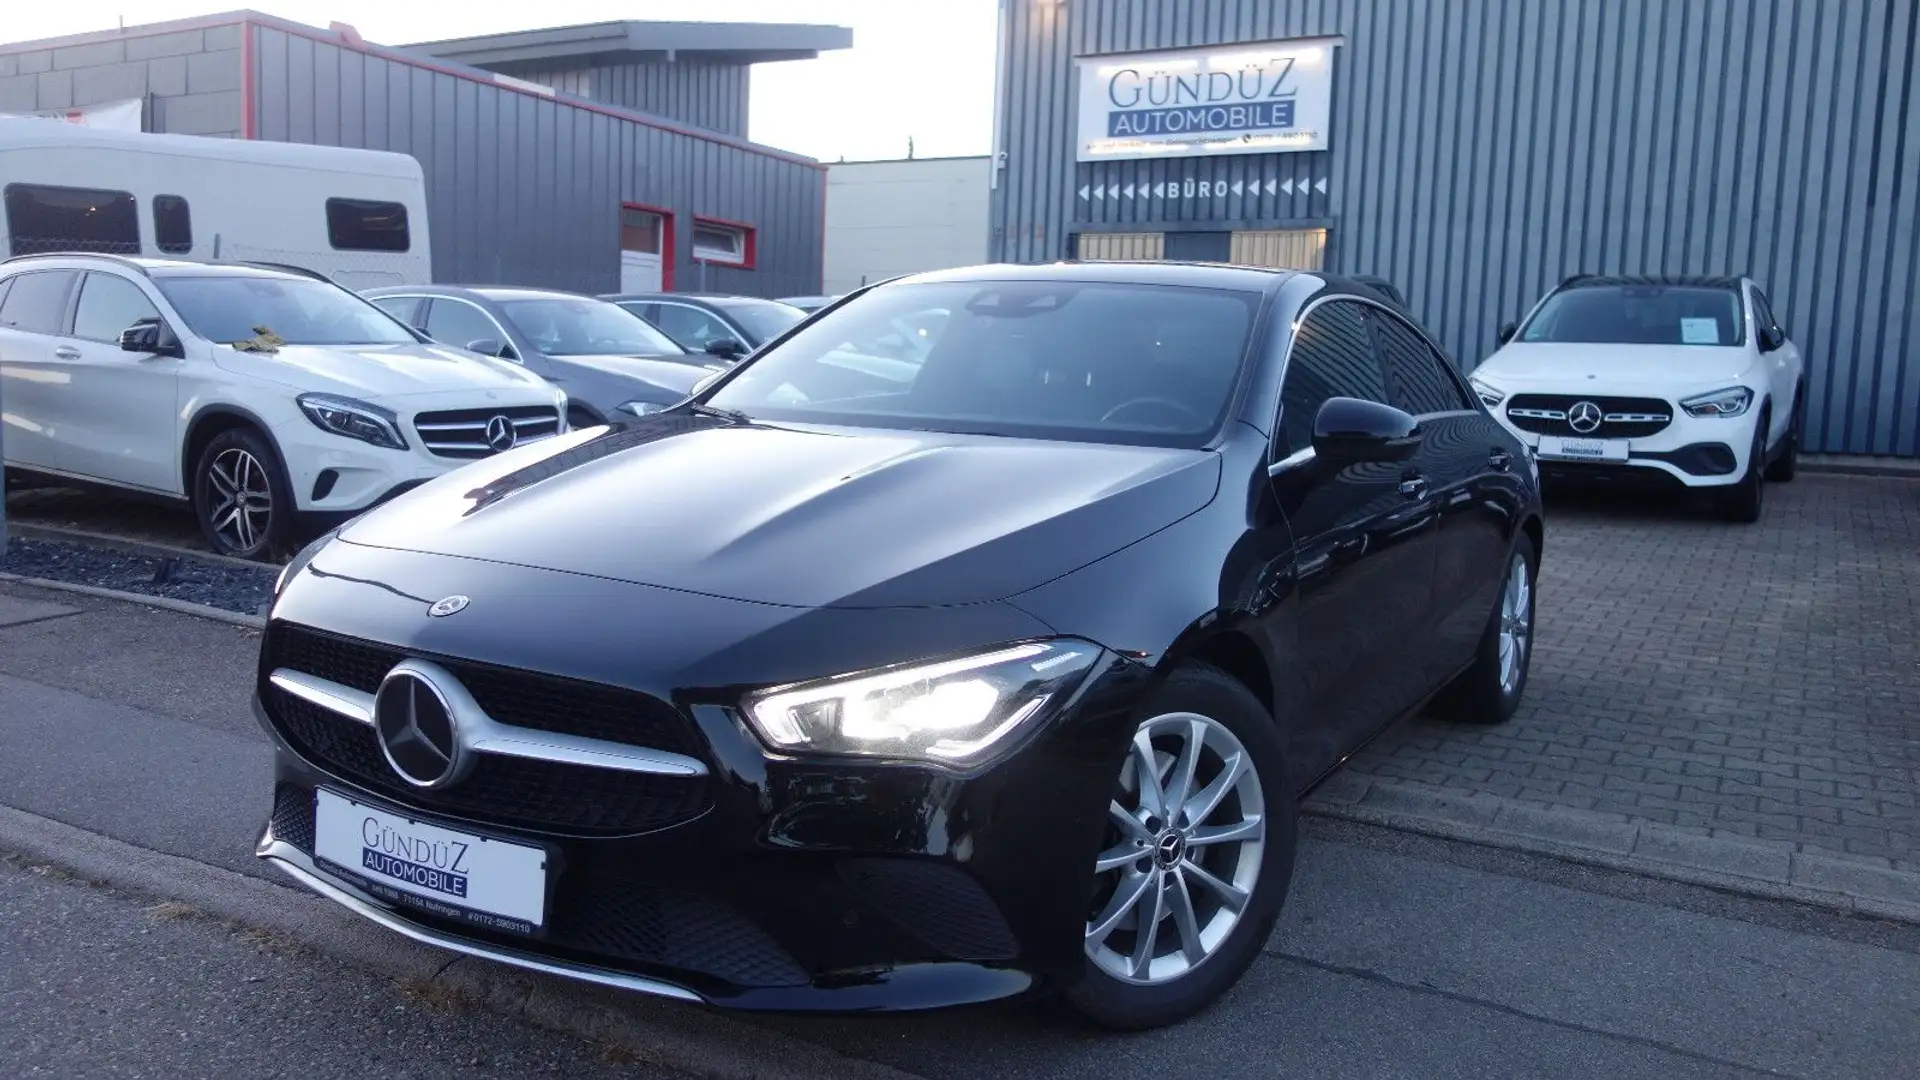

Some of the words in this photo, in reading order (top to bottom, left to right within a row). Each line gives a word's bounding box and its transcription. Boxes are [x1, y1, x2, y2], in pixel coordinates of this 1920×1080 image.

[1109, 57, 1298, 108] GÜNDÜZ
[1114, 104, 1288, 134] AUTOMOBILE
[1167, 178, 1229, 199] BÜRO
[362, 817, 470, 874] GÜNDÜZ
[364, 851, 464, 895] AUTOMOBILE
